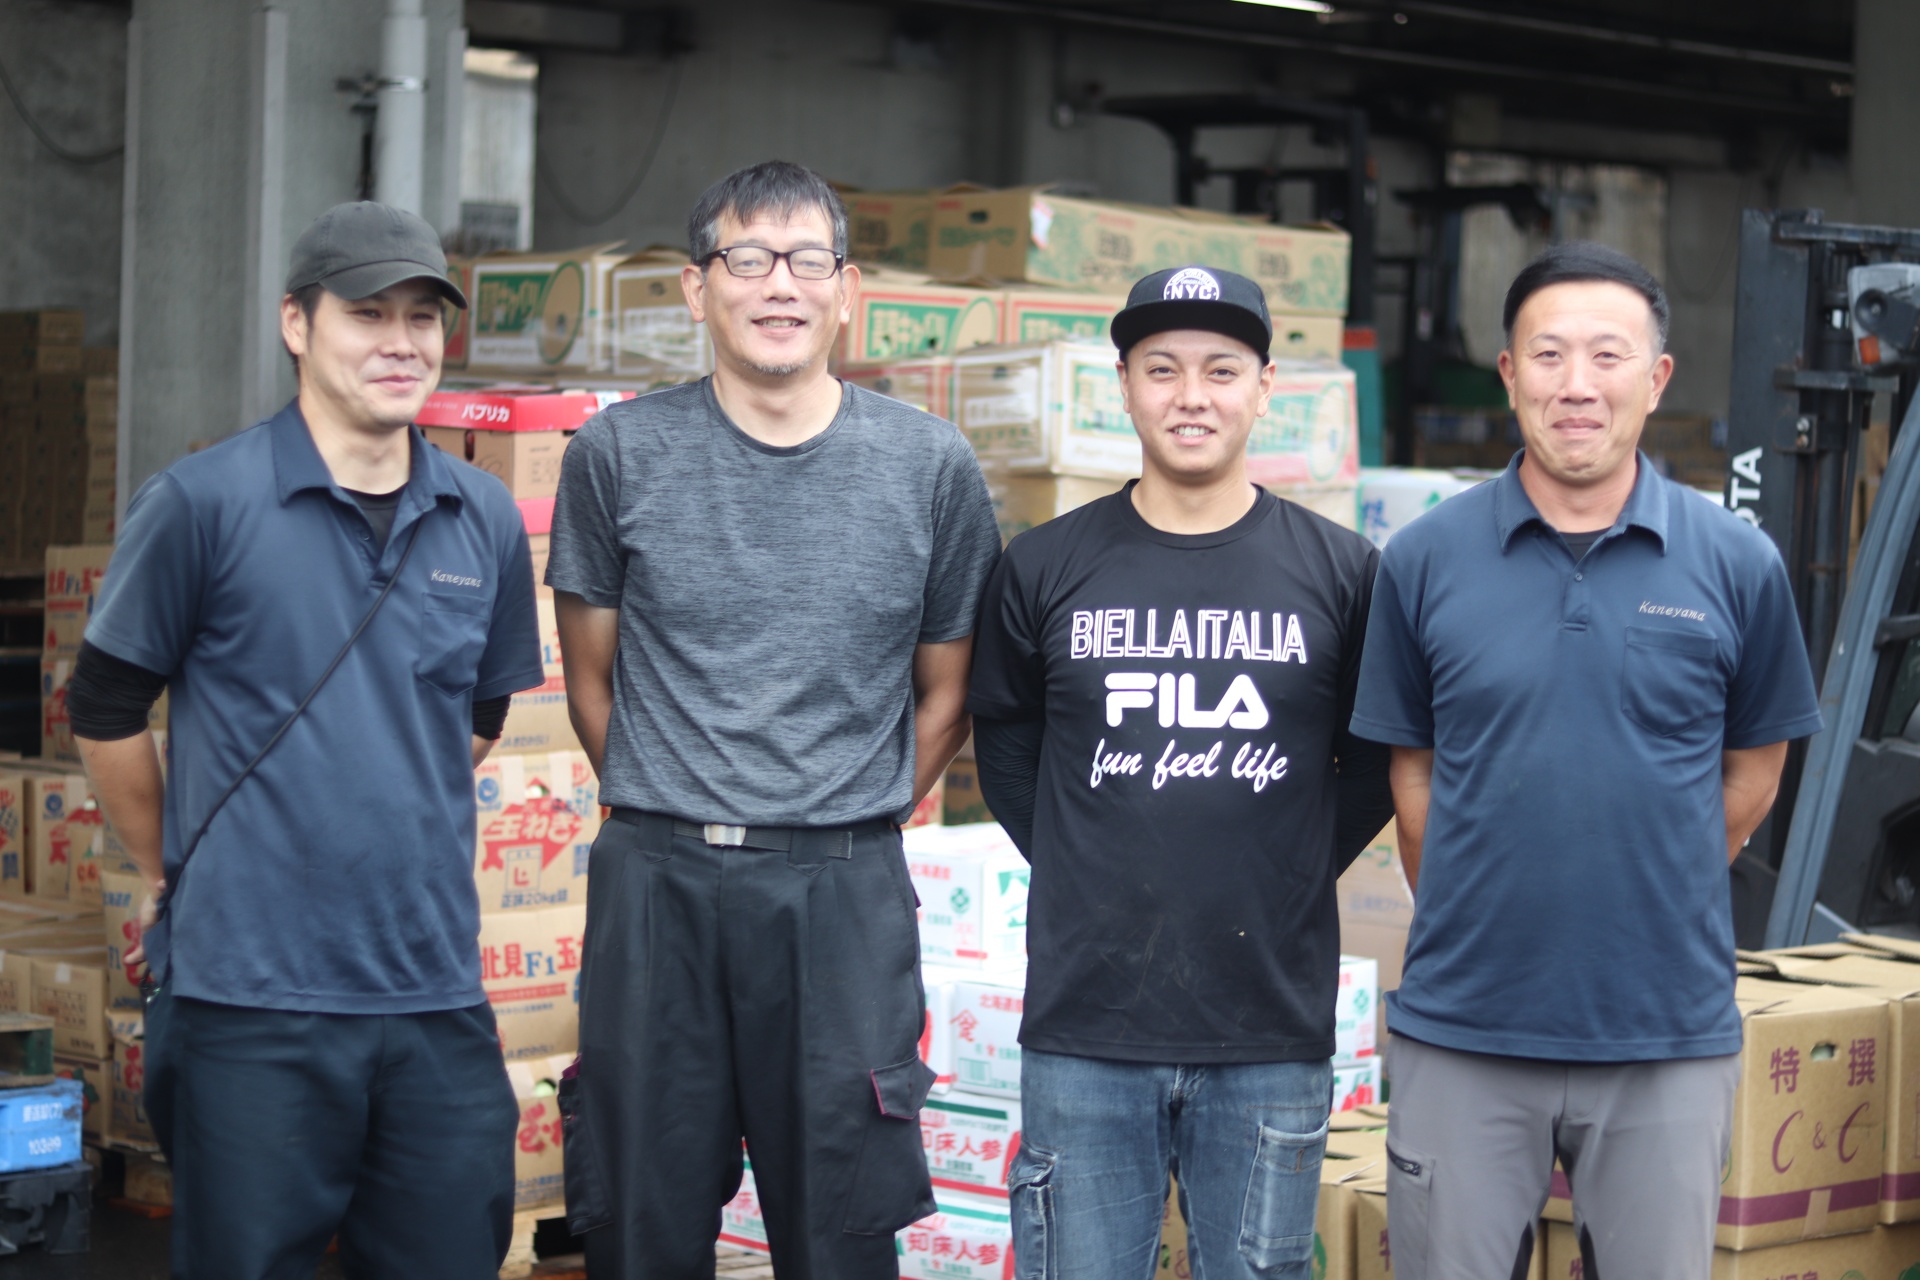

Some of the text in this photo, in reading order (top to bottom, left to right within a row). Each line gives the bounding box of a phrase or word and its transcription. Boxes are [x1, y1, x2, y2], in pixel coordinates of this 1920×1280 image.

[1171, 284, 1212, 299] NYC
[1639, 600, 1706, 621] Kaneyama
[1104, 672, 1269, 730] FILA
[1090, 738, 1288, 793] fun feel life
[481, 936, 583, 981] 北見F1玉
[1772, 1101, 1870, 1175] C & C
[908, 1233, 999, 1265] 知床人参
